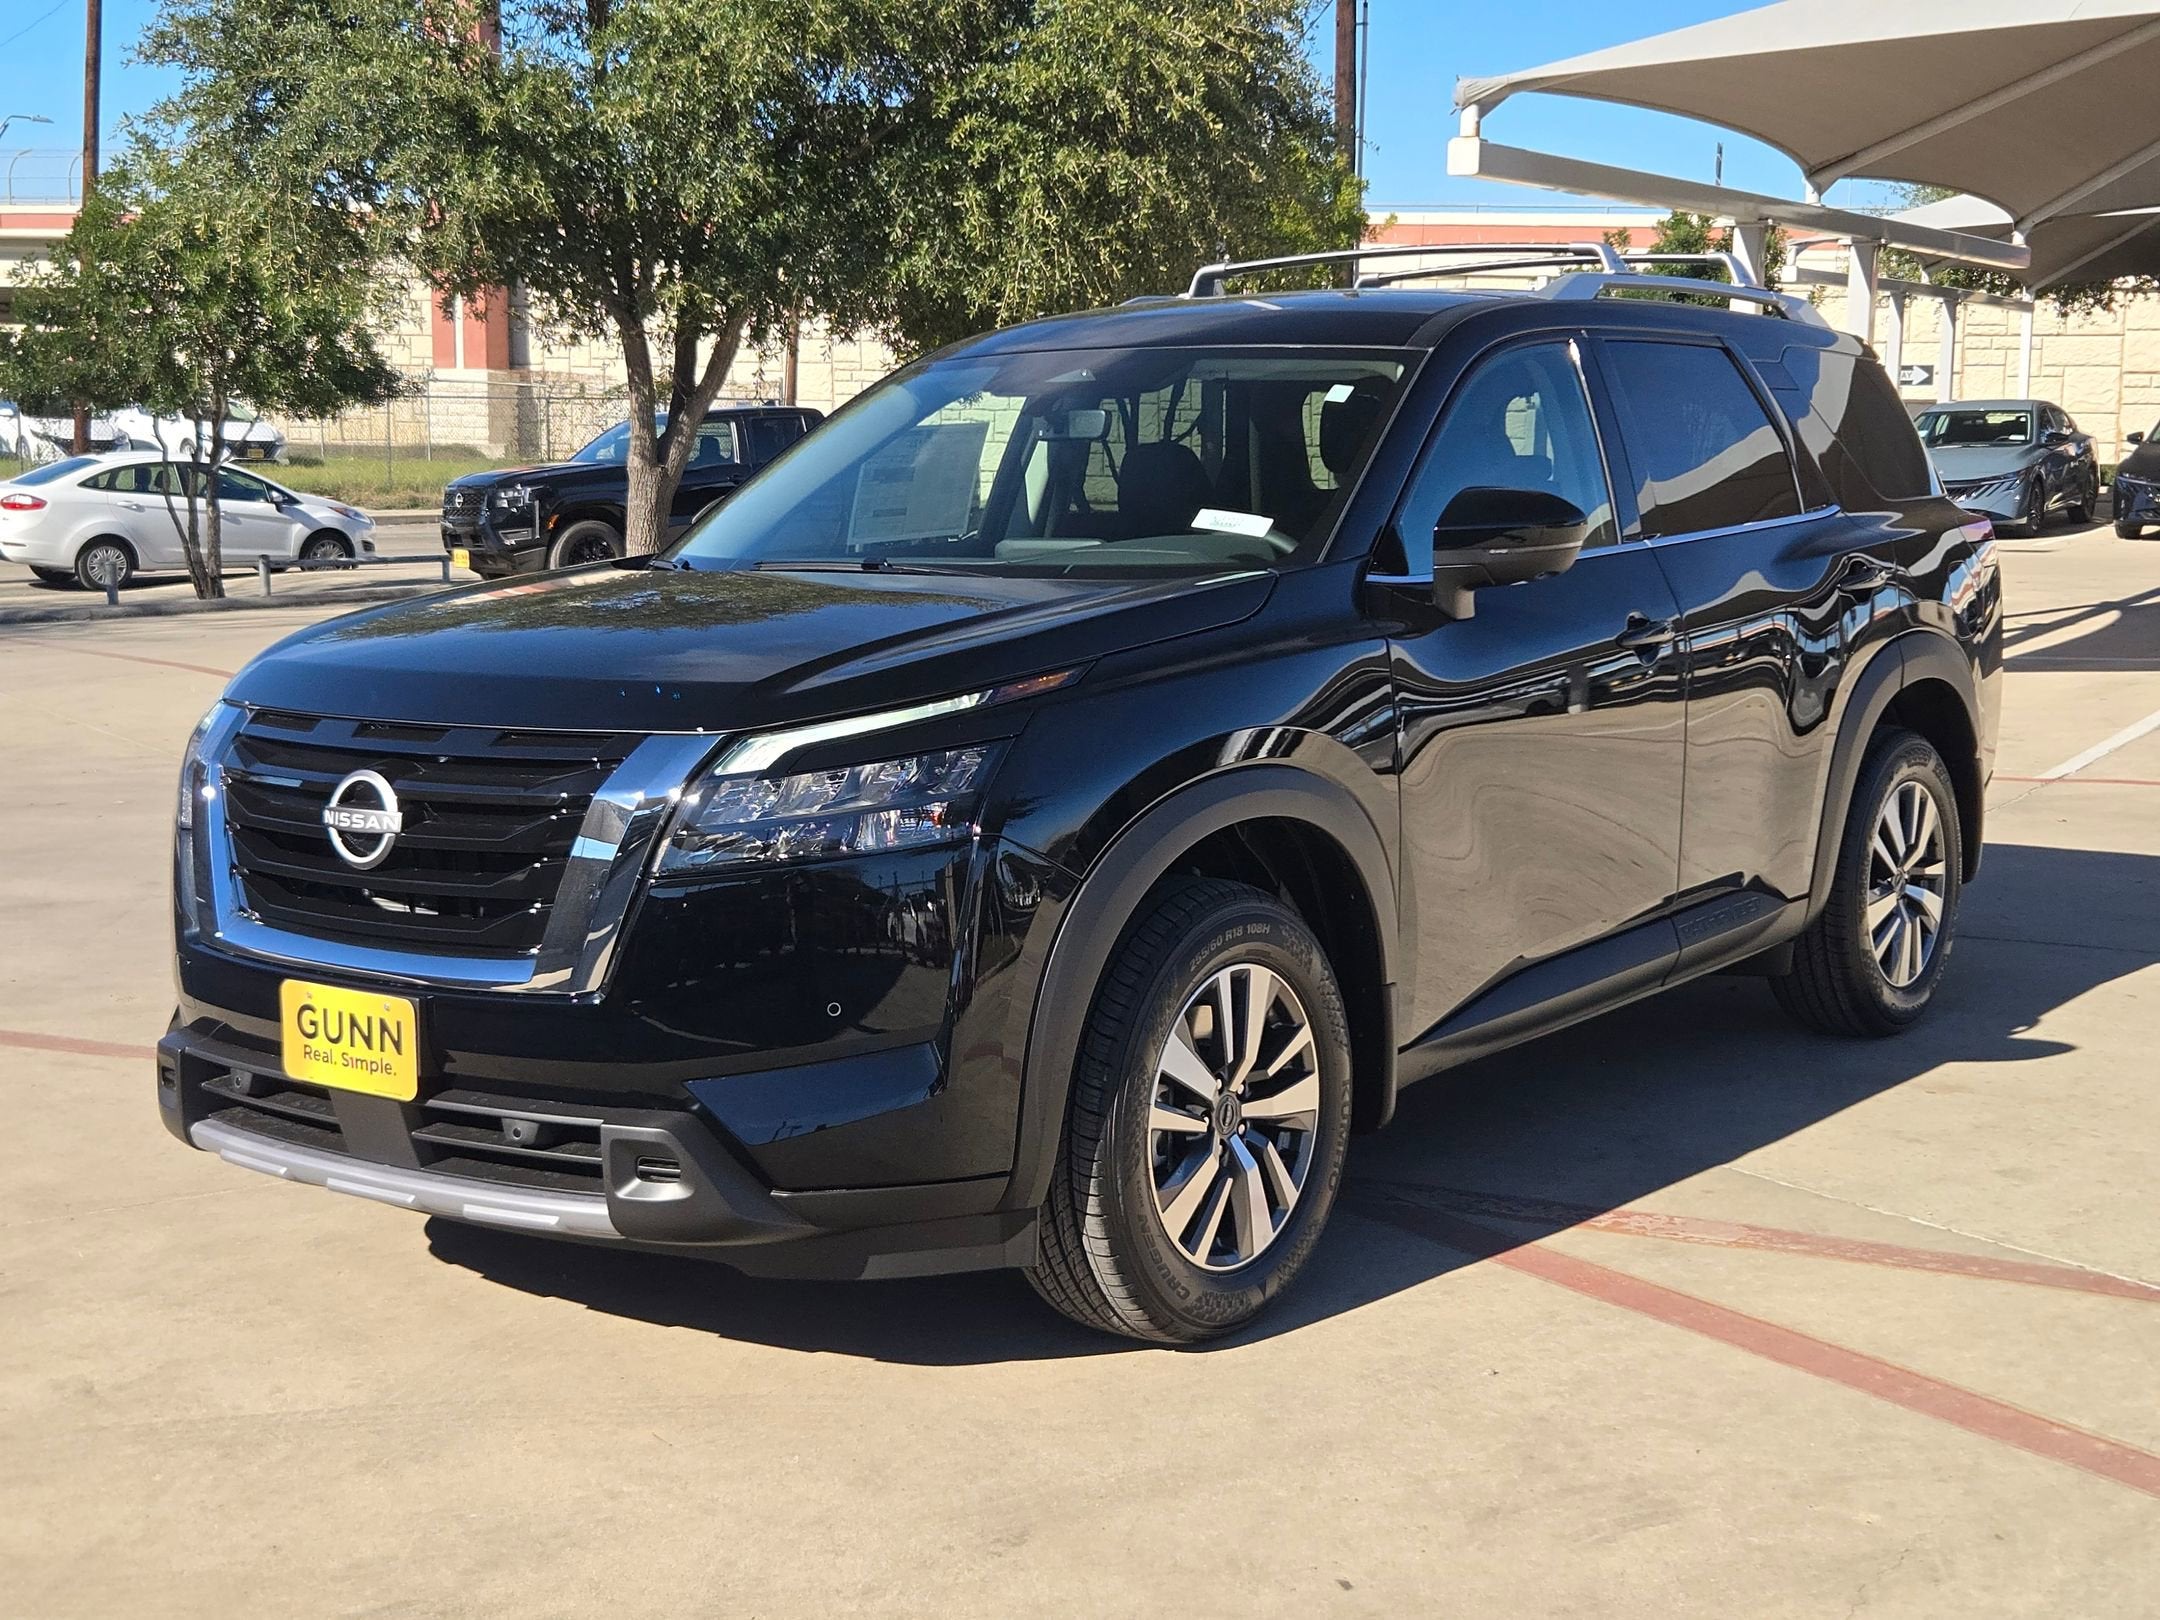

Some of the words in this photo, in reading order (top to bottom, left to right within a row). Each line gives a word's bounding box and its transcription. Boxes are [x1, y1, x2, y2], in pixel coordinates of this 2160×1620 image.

[323, 808, 400, 831] NISSAN
[1189, 934, 1223, 972] 255/60
[1225, 926, 1244, 942] R18
[1247, 922, 1271, 935] 108H
[296, 1003, 403, 1056] GUNN
[303, 1044, 338, 1066] Real.
[341, 1051, 397, 1077] Simple.
